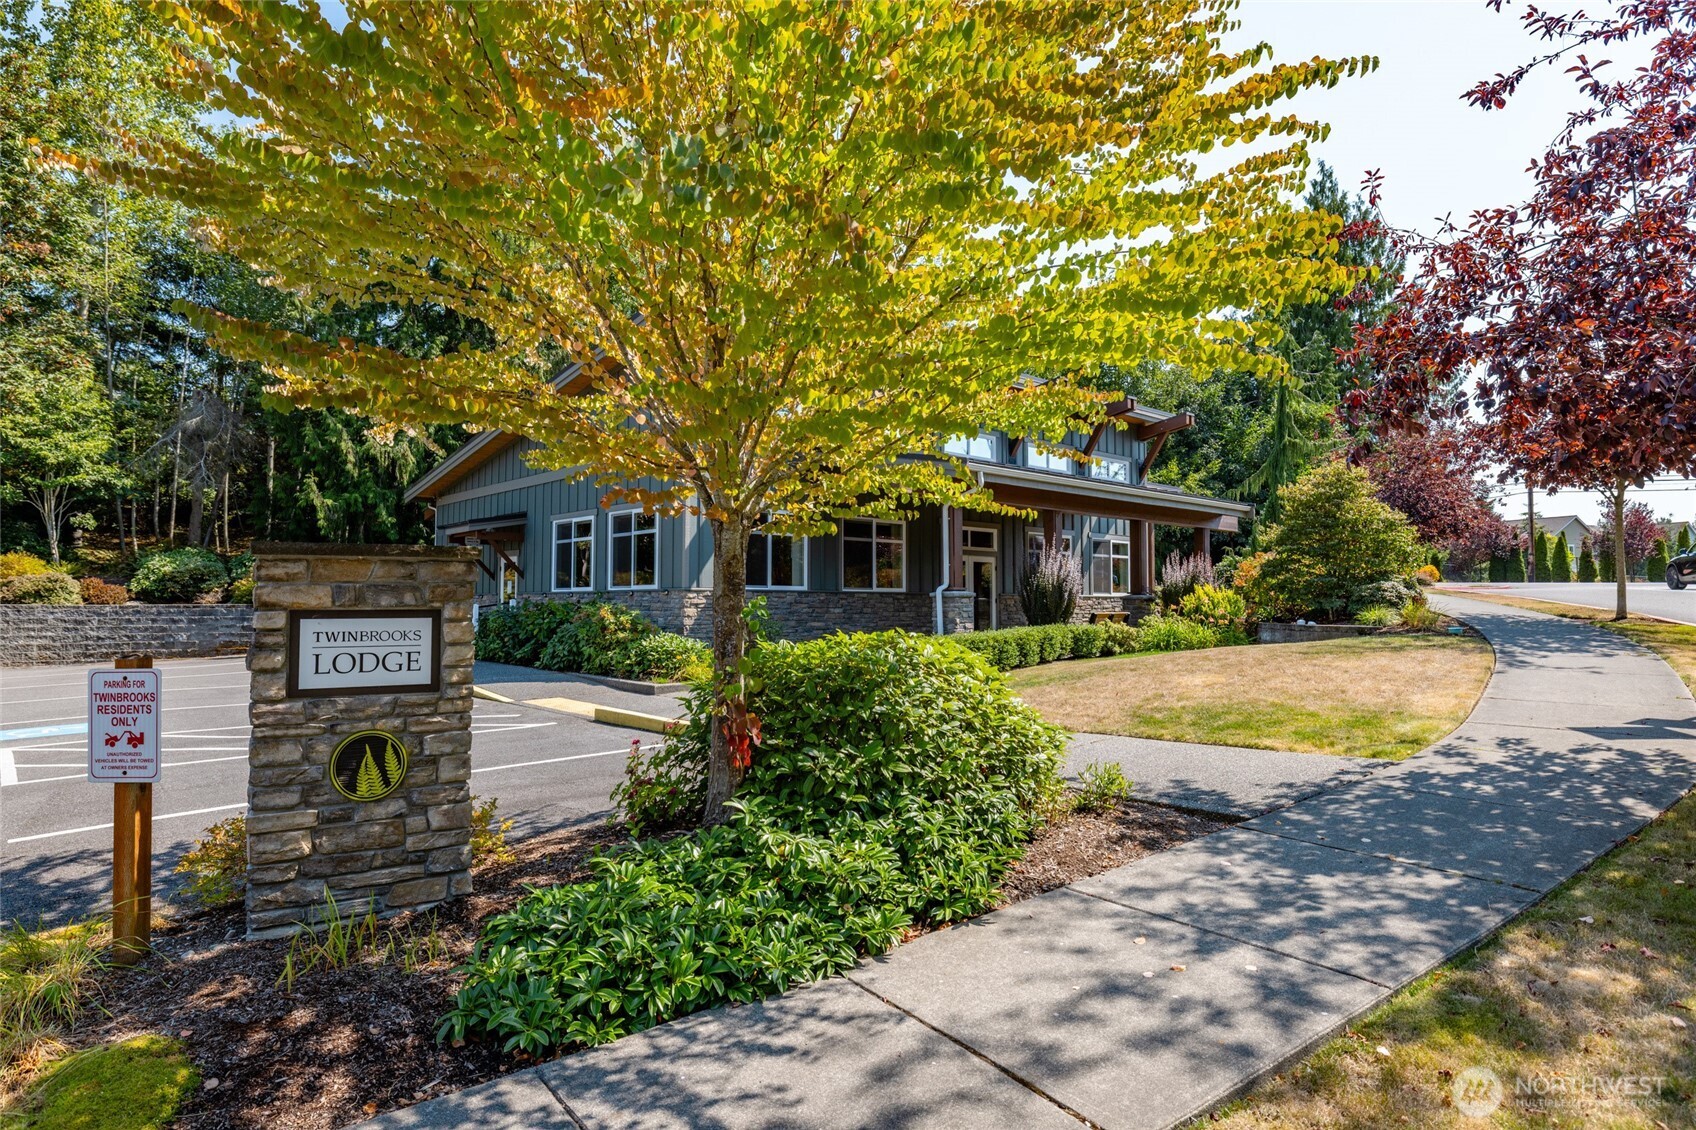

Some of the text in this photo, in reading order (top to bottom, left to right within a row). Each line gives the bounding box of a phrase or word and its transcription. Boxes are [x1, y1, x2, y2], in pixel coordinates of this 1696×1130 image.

[312, 630, 422, 643] TWINBROOKS
[312, 651, 422, 675] LODGE
[103, 680, 146, 688] PARKING FOR
[93, 692, 156, 703] TWINBROOKS
[97, 704, 152, 715] RESIDENTS
[111, 716, 138, 727] ONLY
